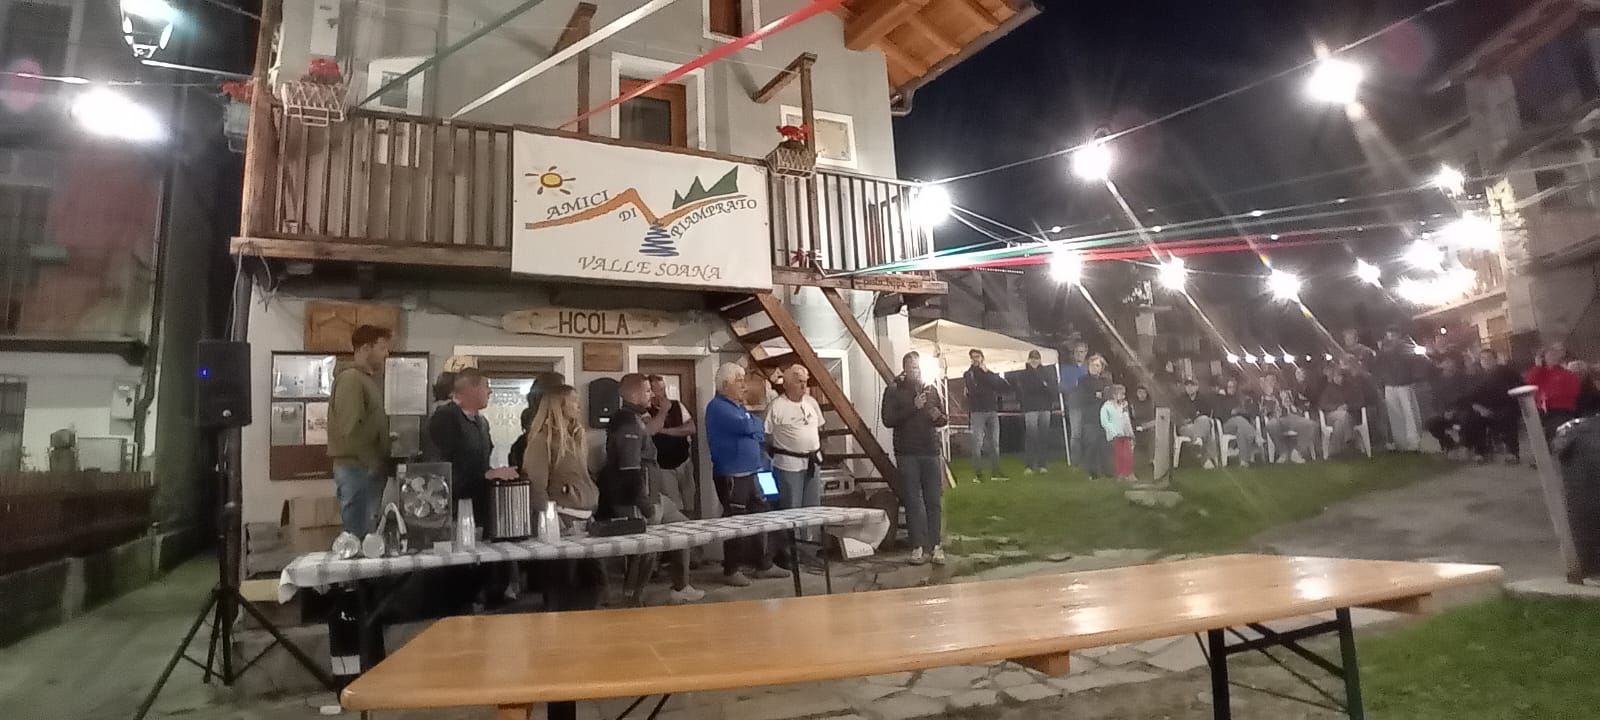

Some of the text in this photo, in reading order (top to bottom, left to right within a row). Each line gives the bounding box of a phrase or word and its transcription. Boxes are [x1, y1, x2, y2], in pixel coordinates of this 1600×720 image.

[547, 190, 758, 239] AMICI DI PIAMPRATO
[578, 256, 722, 281] VALLE SOANA
[558, 311, 629, 335] HCOLA
